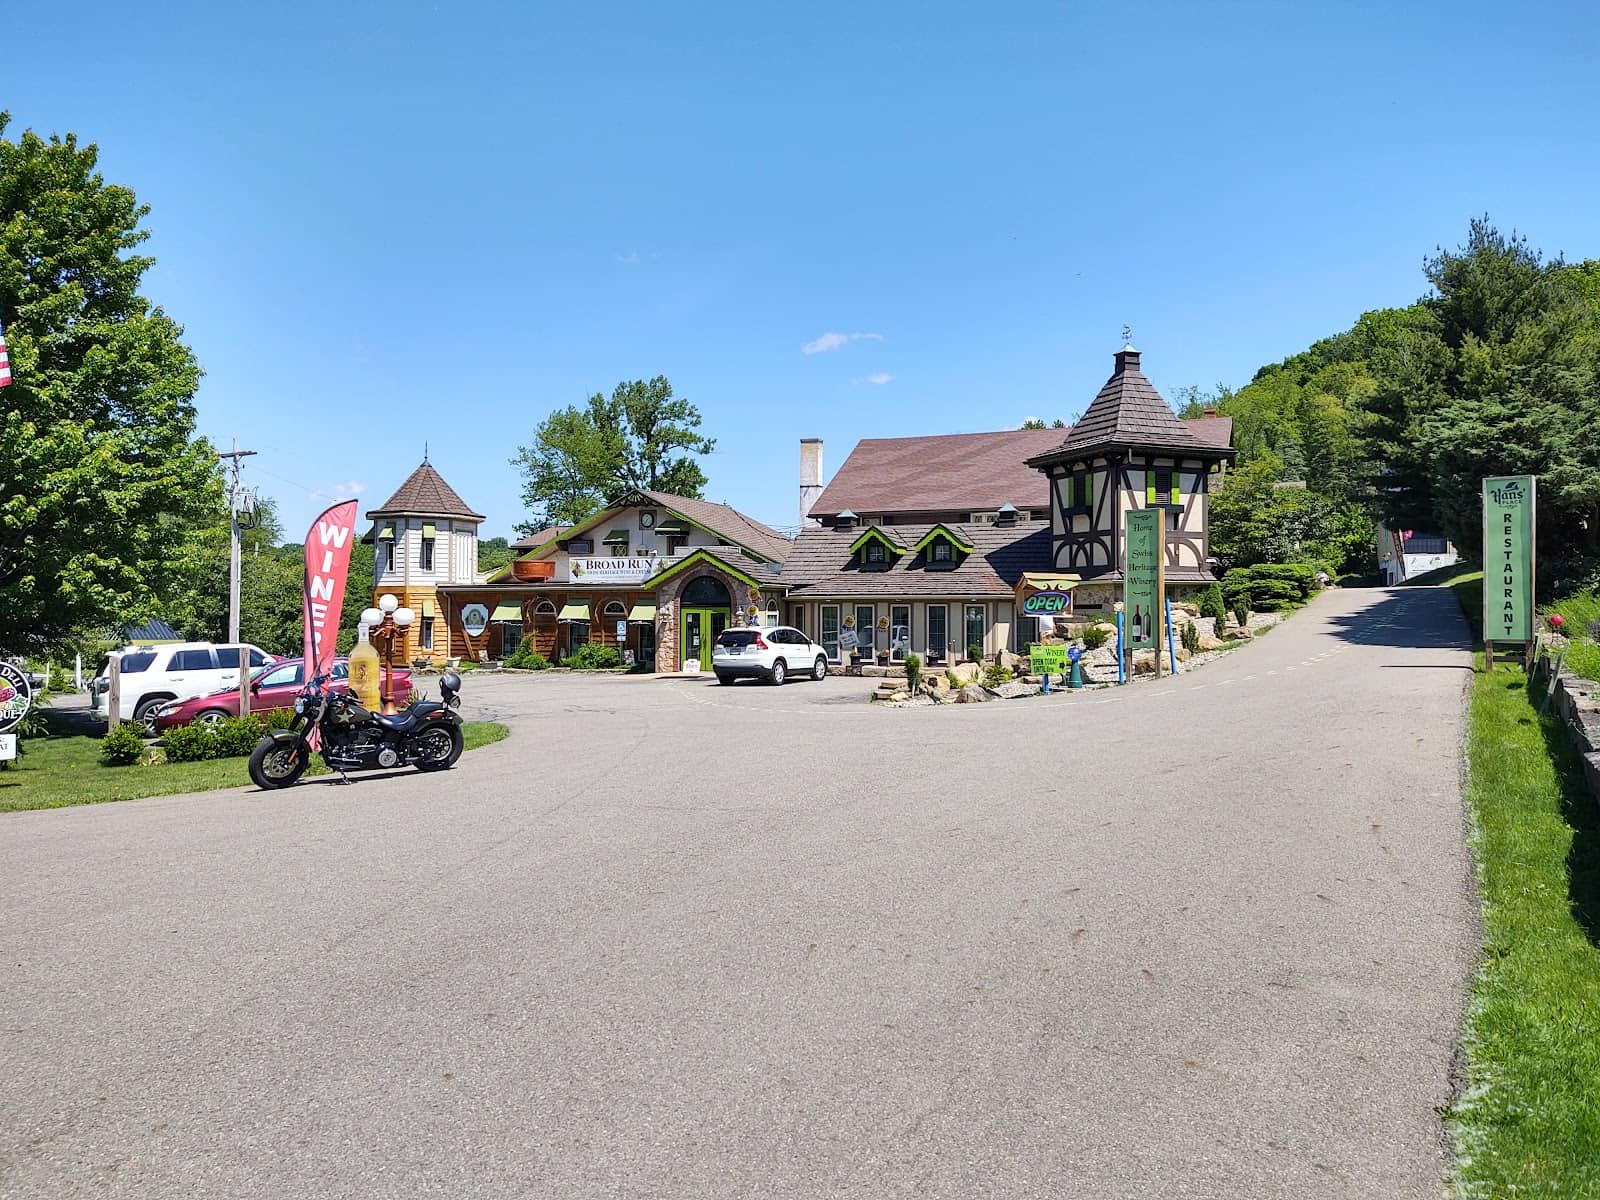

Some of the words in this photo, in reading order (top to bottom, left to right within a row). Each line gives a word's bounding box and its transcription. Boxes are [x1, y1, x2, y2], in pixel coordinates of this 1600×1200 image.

[1134, 523, 1153, 532] Home
[1138, 535, 1147, 547] of
[1132, 549, 1153, 560] Swiss
[586, 560, 625, 570] BROAD
[628, 559, 652, 569] RUN
[1128, 563, 1158, 574] Heritage
[1503, 513, 1513, 636] RESTAURANT
[1127, 577, 1157, 588] Winery
[1026, 596, 1065, 610] OPEN
[1, 667, 23, 687] DELI
